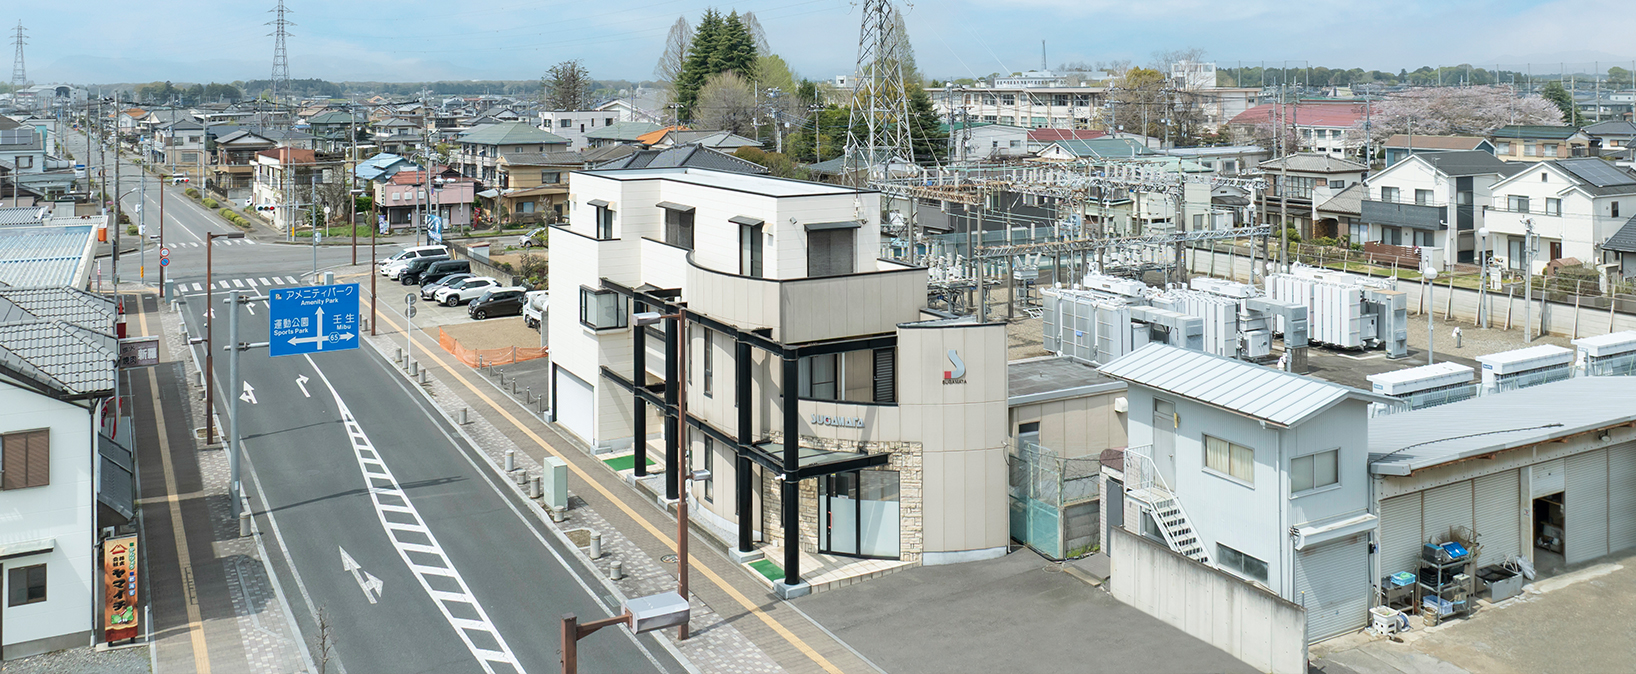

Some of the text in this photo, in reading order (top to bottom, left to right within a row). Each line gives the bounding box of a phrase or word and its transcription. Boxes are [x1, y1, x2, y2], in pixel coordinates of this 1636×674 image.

[286, 286, 353, 300] アメニティパーク
[274, 317, 309, 329] 運動公園
[333, 313, 355, 324] 壬生
[112, 569, 126, 611] ヤマイチ
